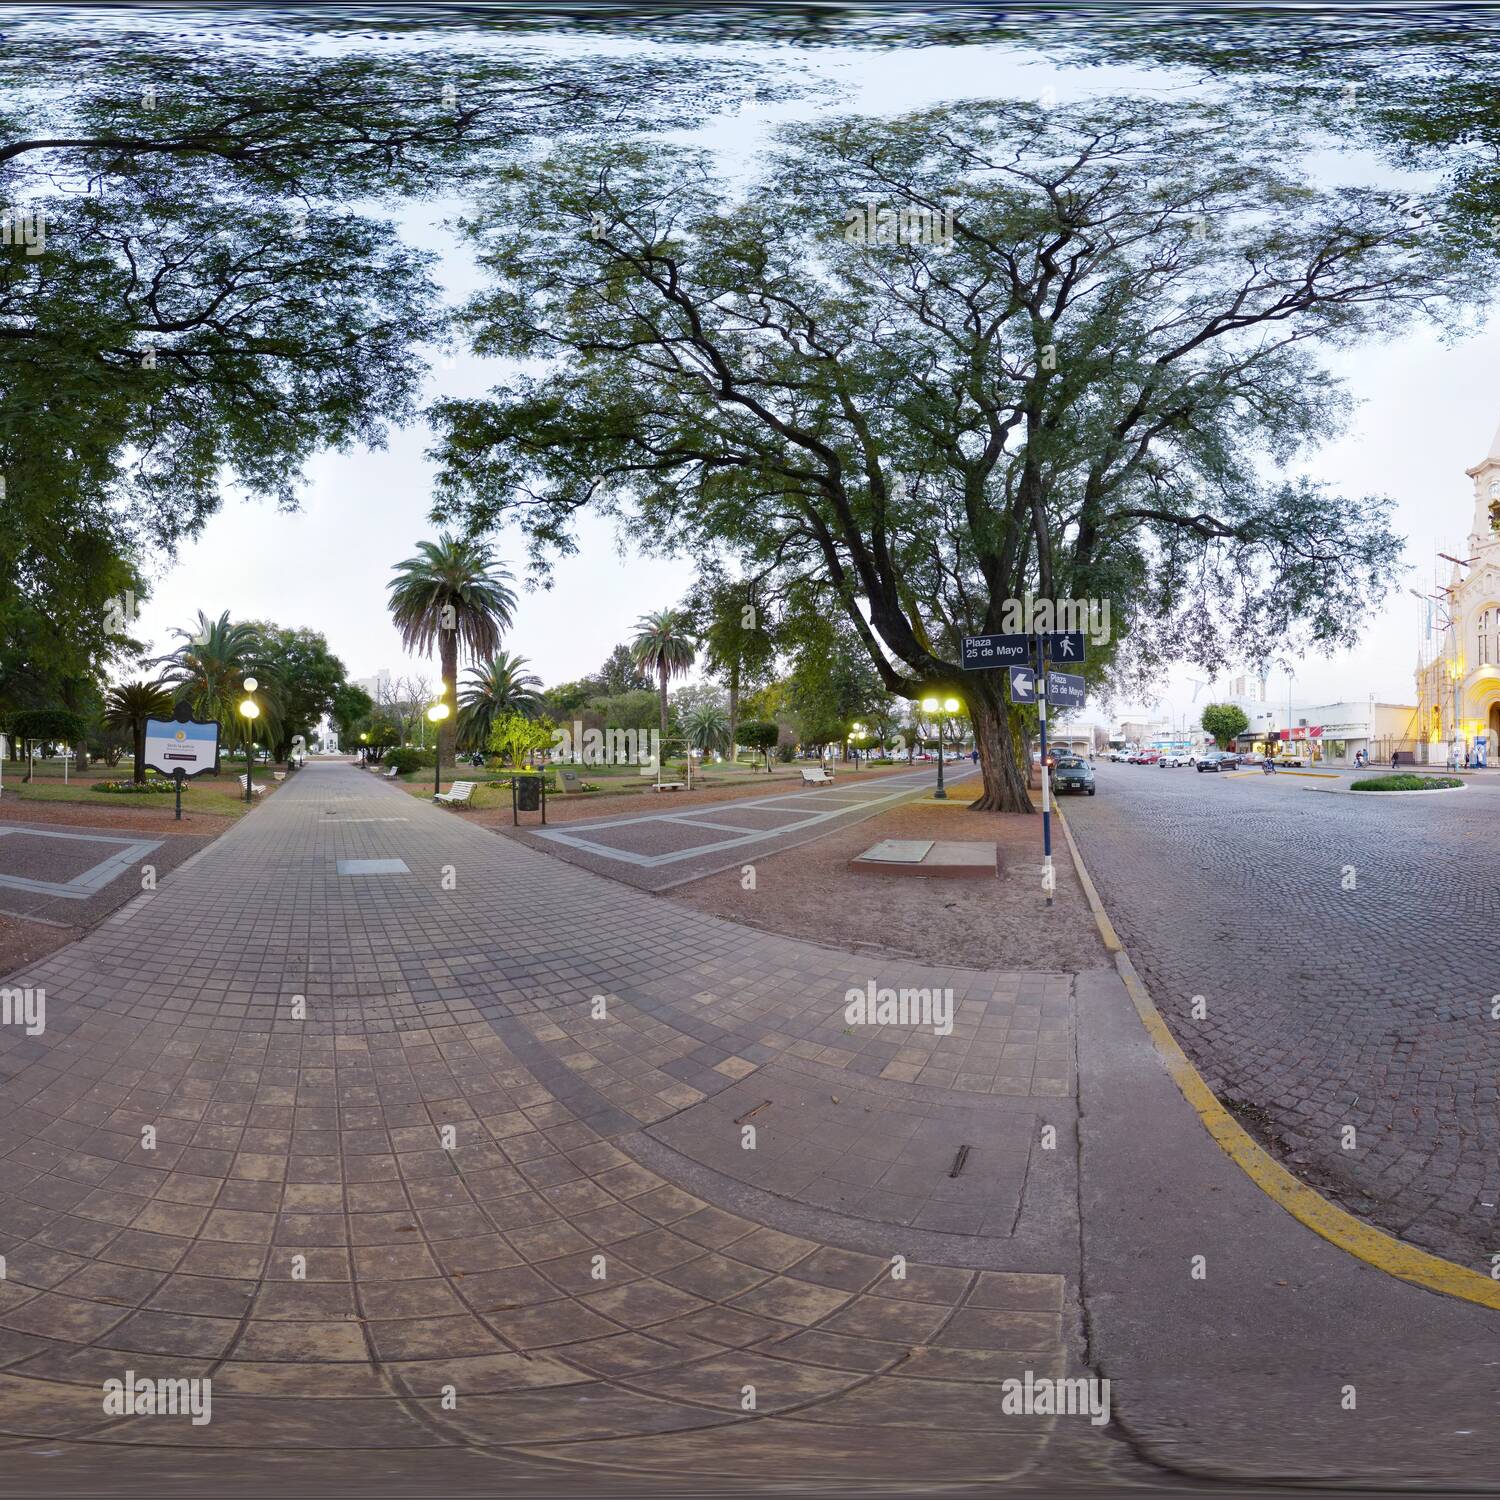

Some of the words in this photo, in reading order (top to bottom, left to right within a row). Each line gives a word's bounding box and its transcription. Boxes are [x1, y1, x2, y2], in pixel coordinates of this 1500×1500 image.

[966, 638, 991, 648] Plaza
[966, 649, 978, 658] 25
[981, 647, 993, 657] de
[996, 645, 1023, 657] Mayo
[1050, 673, 1067, 684] Plaza
[1051, 684, 1059, 694] 25
[1060, 686, 1068, 694] de
[1069, 687, 1084, 698] Mayo
